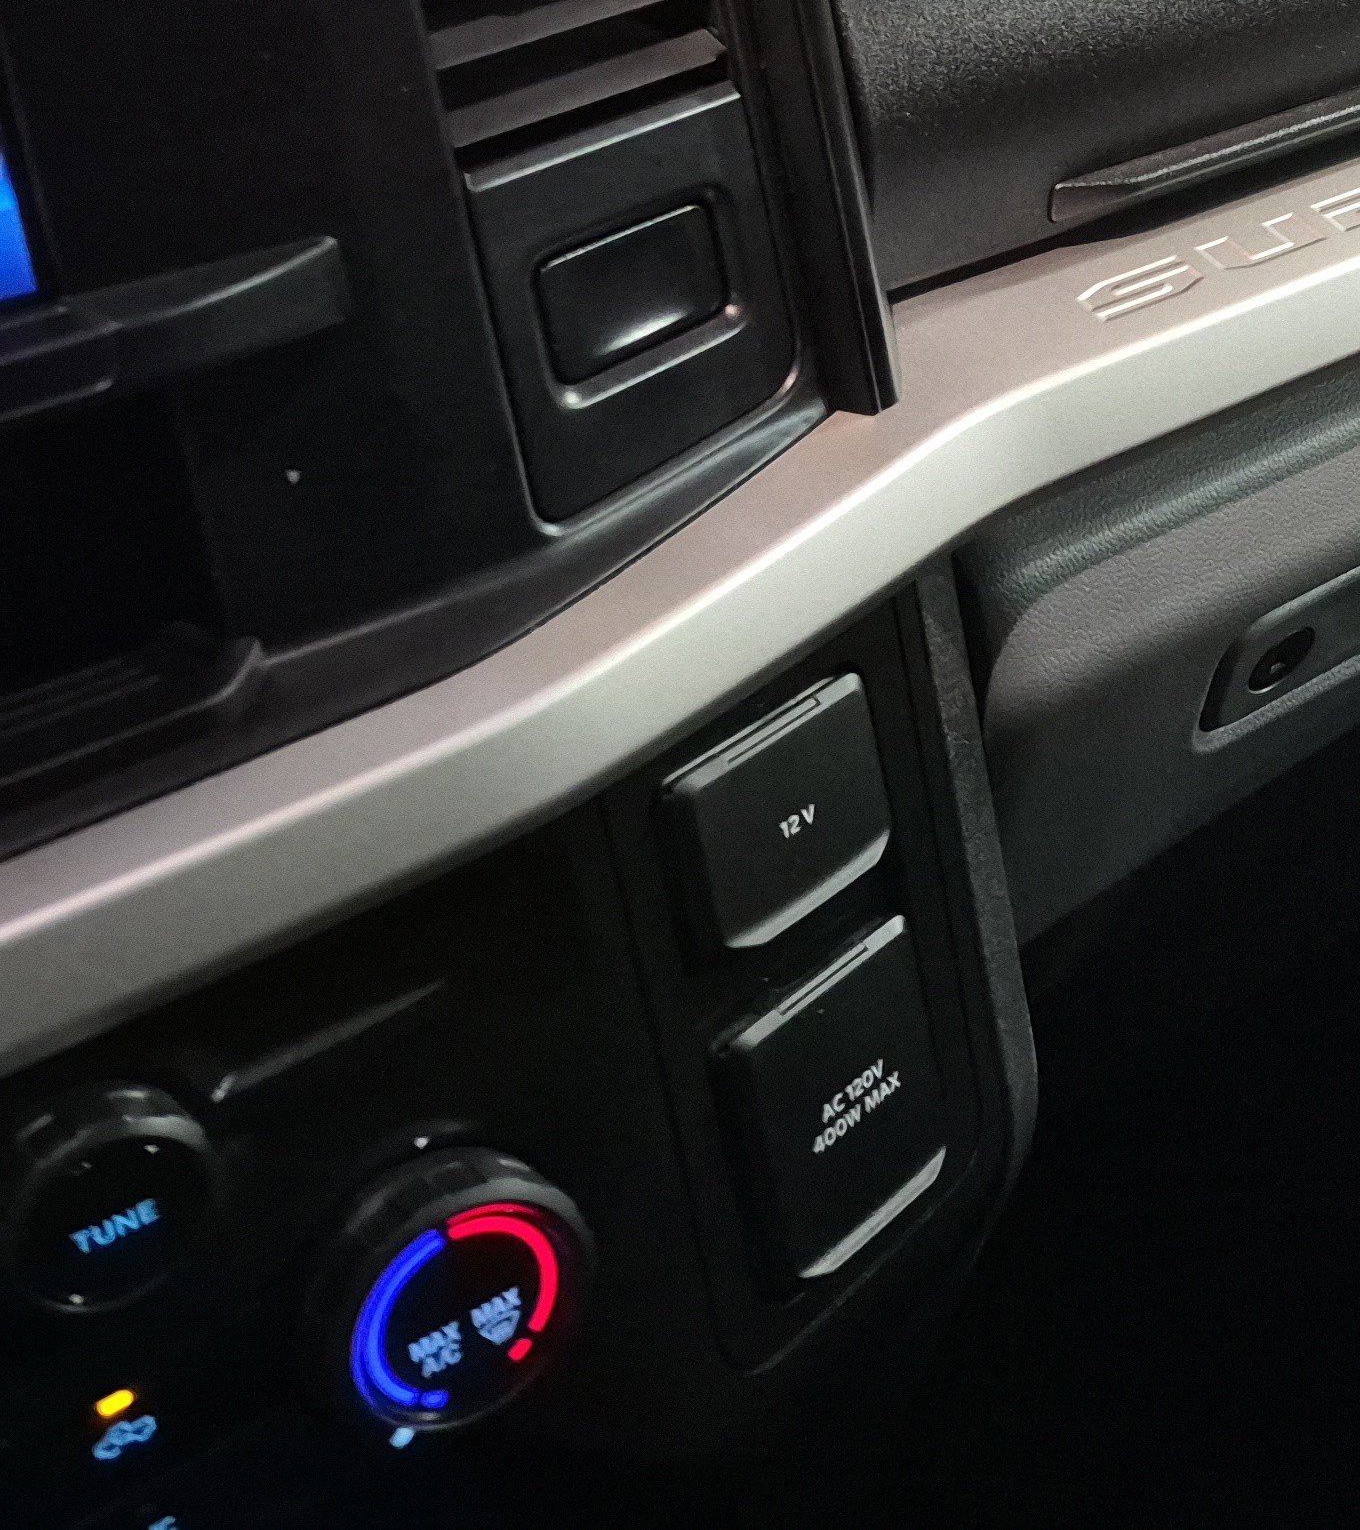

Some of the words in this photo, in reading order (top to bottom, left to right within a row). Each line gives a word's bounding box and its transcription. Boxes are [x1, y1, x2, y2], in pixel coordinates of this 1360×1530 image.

[779, 814, 802, 839] 12
[800, 803, 816, 825] V
[812, 1103, 862, 1154] 400W
[863, 1070, 902, 1114] MAX
[822, 1092, 846, 1124] AC
[844, 1058, 884, 1102] 120V
[69, 1198, 160, 1254] TUNE
[470, 1285, 522, 1329] MAX
[407, 1320, 462, 1363] MAX
[421, 1342, 464, 1379] A/C
